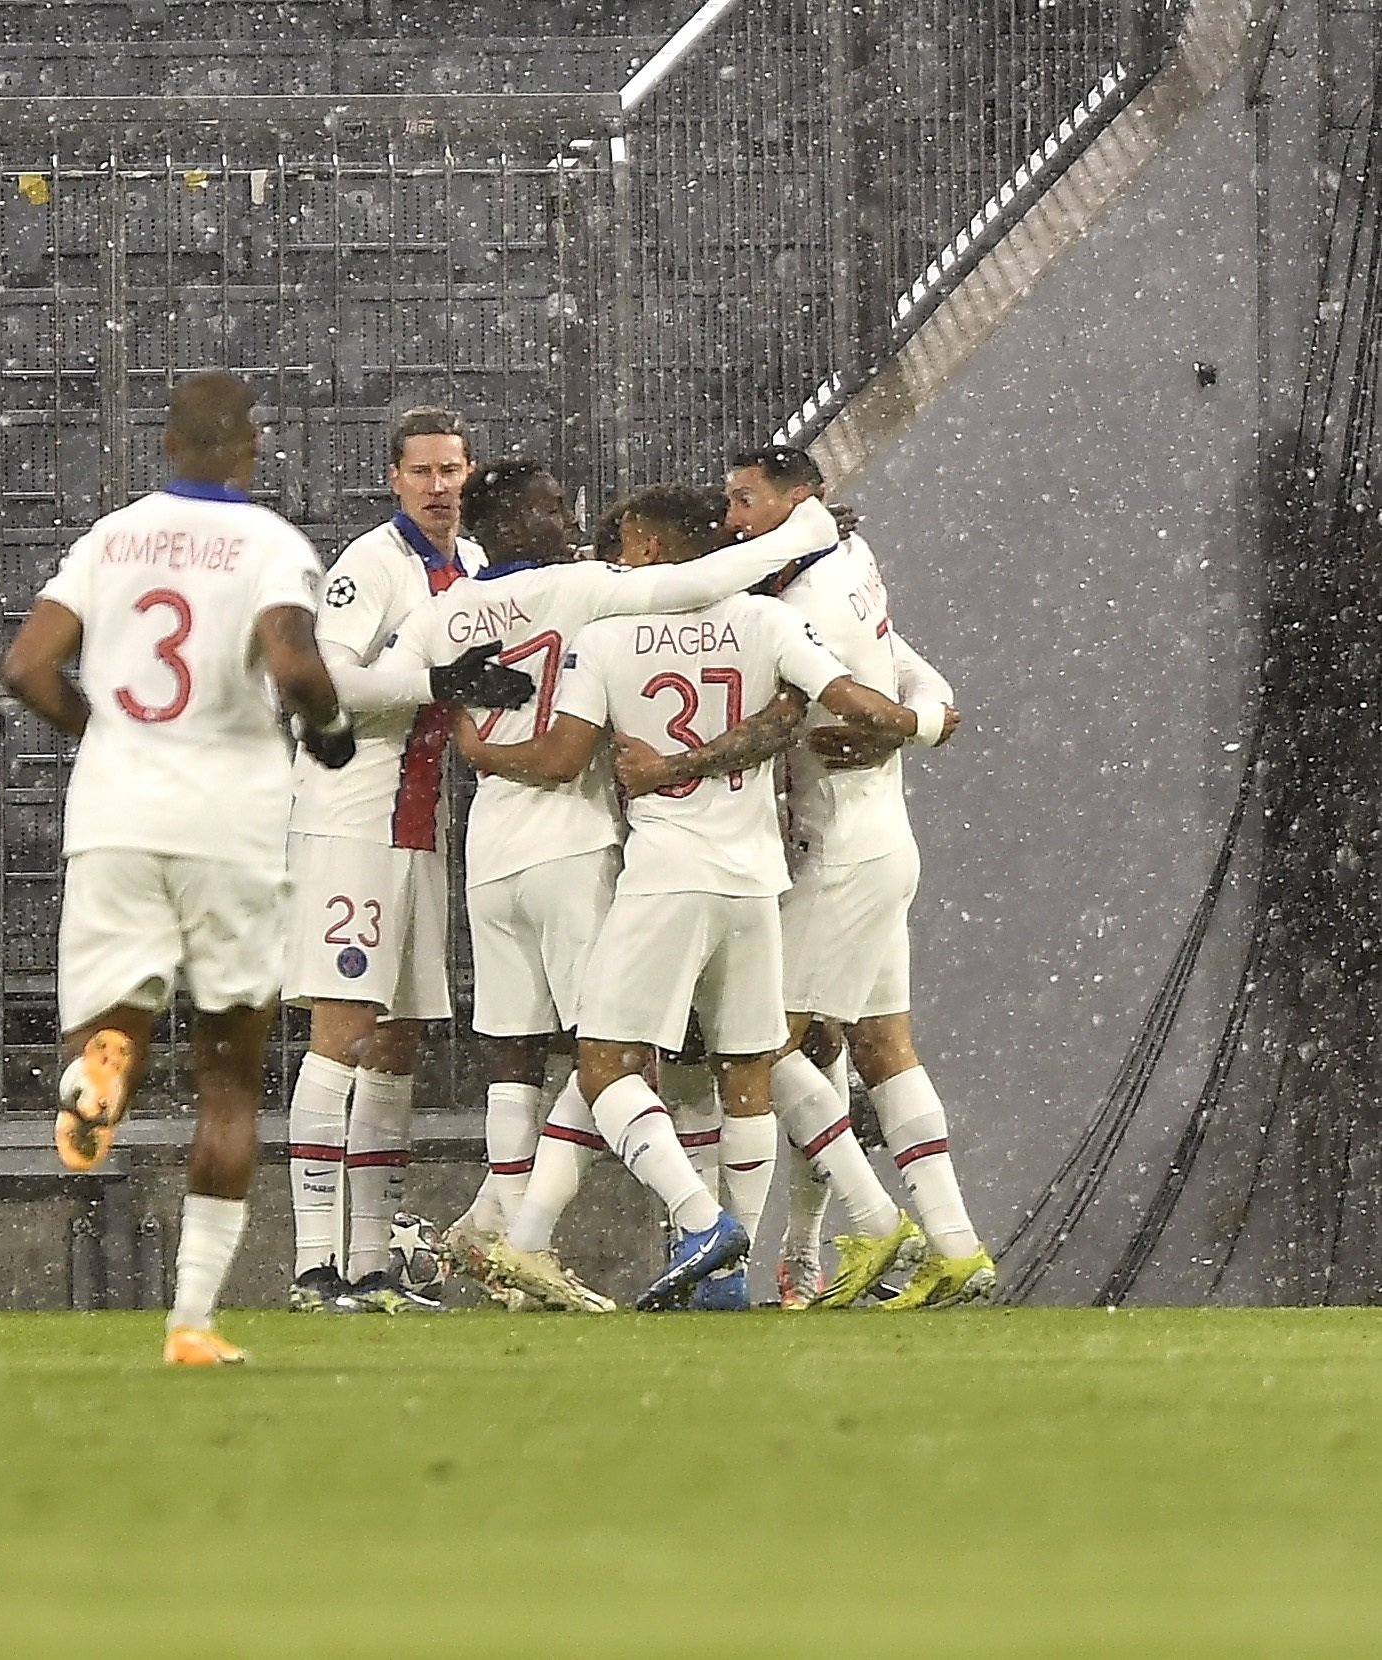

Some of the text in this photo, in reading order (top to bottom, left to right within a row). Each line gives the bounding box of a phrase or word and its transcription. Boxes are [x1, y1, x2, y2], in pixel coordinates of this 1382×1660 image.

[447, 597, 533, 643] GANA
[636, 621, 741, 655] DAGBA
[115, 587, 193, 722] 3
[641, 667, 743, 799] 37
[324, 895, 381, 948] 23
